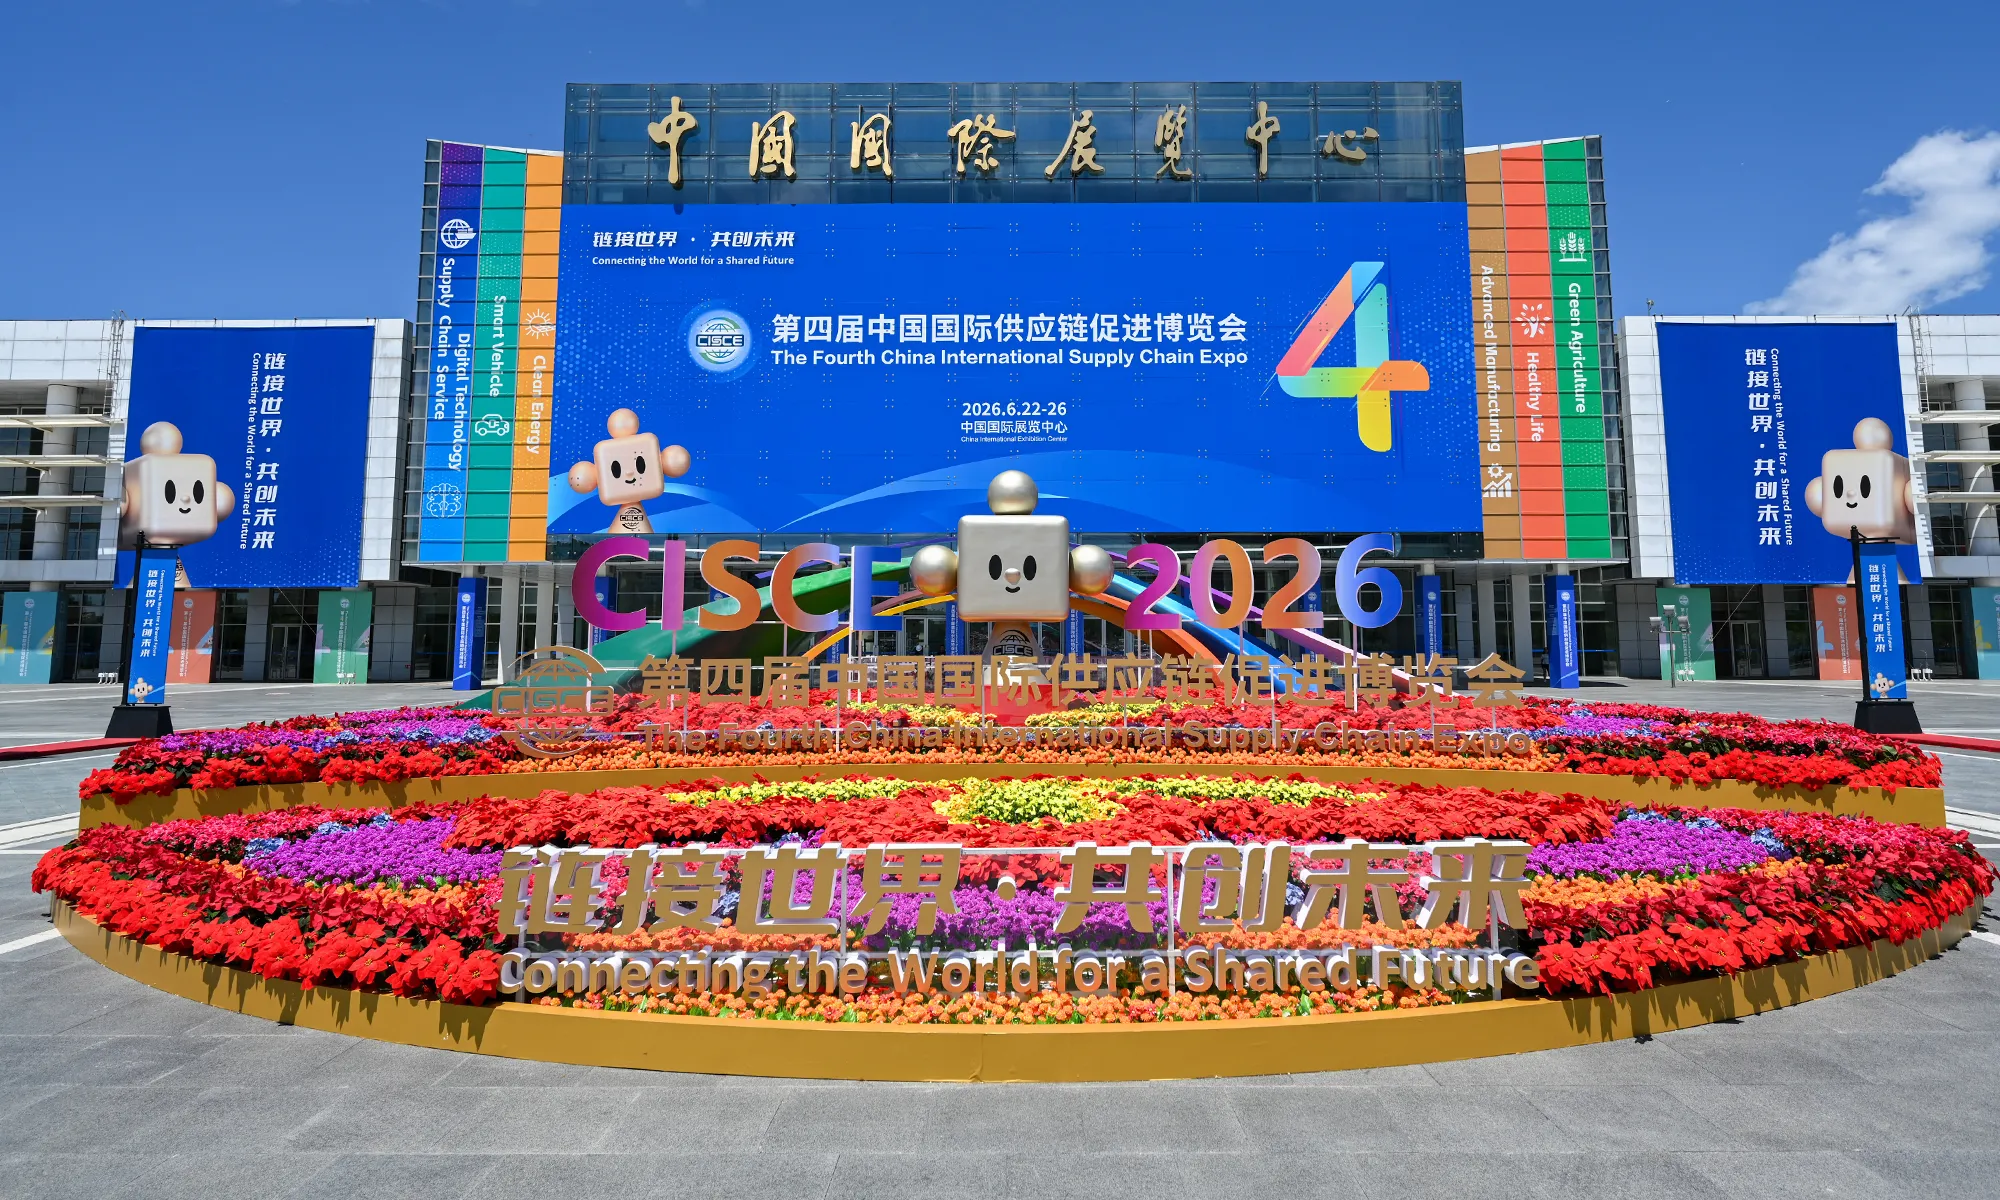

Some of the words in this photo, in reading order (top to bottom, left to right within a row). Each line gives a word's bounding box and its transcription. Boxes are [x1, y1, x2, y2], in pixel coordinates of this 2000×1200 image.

[647, 95, 1379, 189] 中國國際展覽中心
[592, 256, 646, 267] Connecting
[649, 256, 666, 265] the
[668, 256, 698, 265] World
[700, 255, 715, 265] for
[726, 256, 760, 265] Shared
[763, 256, 795, 265] Future
[437, 258, 455, 308] Supply
[1481, 265, 1498, 339] Advanced
[1568, 282, 1581, 326] Green
[437, 315, 452, 357] Chain
[492, 295, 506, 338] Smart
[771, 313, 1248, 344] 第四届中国国际供应链促进博览会
[454, 333, 471, 381] Digital
[697, 335, 744, 347] CISCE
[771, 350, 807, 364] The
[813, 350, 875, 365] Fourth
[881, 349, 936, 365] China
[942, 349, 1063, 364] International
[1069, 349, 1135, 368] Supply
[1140, 349, 1194, 364] Chain
[1200, 349, 1248, 368] Expo
[1275, 261, 1430, 452] 4
[248, 352, 261, 404] Connecting
[489, 342, 505, 397] Vehicle
[532, 355, 546, 397] Clean
[1526, 352, 1542, 410] Healthy
[1568, 331, 1588, 413] Agriculture
[1770, 348, 1783, 401] Connecting
[249, 405, 257, 423] the
[434, 366, 449, 420] Service
[962, 402, 1067, 416] 2026.6.22-26
[1485, 342, 1502, 452] Manufacturing
[1775, 402, 1783, 418] the
[247, 424, 256, 454] World
[448, 385, 468, 472] Technology
[526, 402, 544, 454] Energy
[961, 421, 1068, 434] 中国国际展览中心
[1531, 415, 1544, 442] Life
[1776, 420, 1787, 450] World
[246, 455, 255, 471] for
[1779, 451, 1787, 466] for
[243, 482, 253, 515] Shared
[1781, 478, 1792, 511] Shared
[240, 517, 250, 550] Future
[1783, 513, 1793, 545] Future
[158, 569, 166, 593] Connecting
[571, 536, 902, 632] CISCE
[1124, 533, 1403, 630] 2026
[994, 645, 1033, 656] CISCE
[497, 689, 609, 714] CISCE
[637, 653, 1527, 710] 第四届中国国际供应链促进博览会
[637, 723, 707, 752] The
[717, 721, 833, 750] Fourth
[843, 718, 943, 750] China
[954, 718, 1172, 749] International
[1183, 720, 1303, 756] Supply
[1314, 721, 1420, 753] Chain
[1432, 722, 1532, 758] Expo
[500, 944, 773, 1001] Connecting
[787, 944, 870, 995] the
[886, 938, 1040, 995] World
[1053, 942, 1127, 993] for
[1141, 952, 1172, 993] a
[1184, 942, 1360, 993] Shared
[1370, 942, 1540, 991] Future
